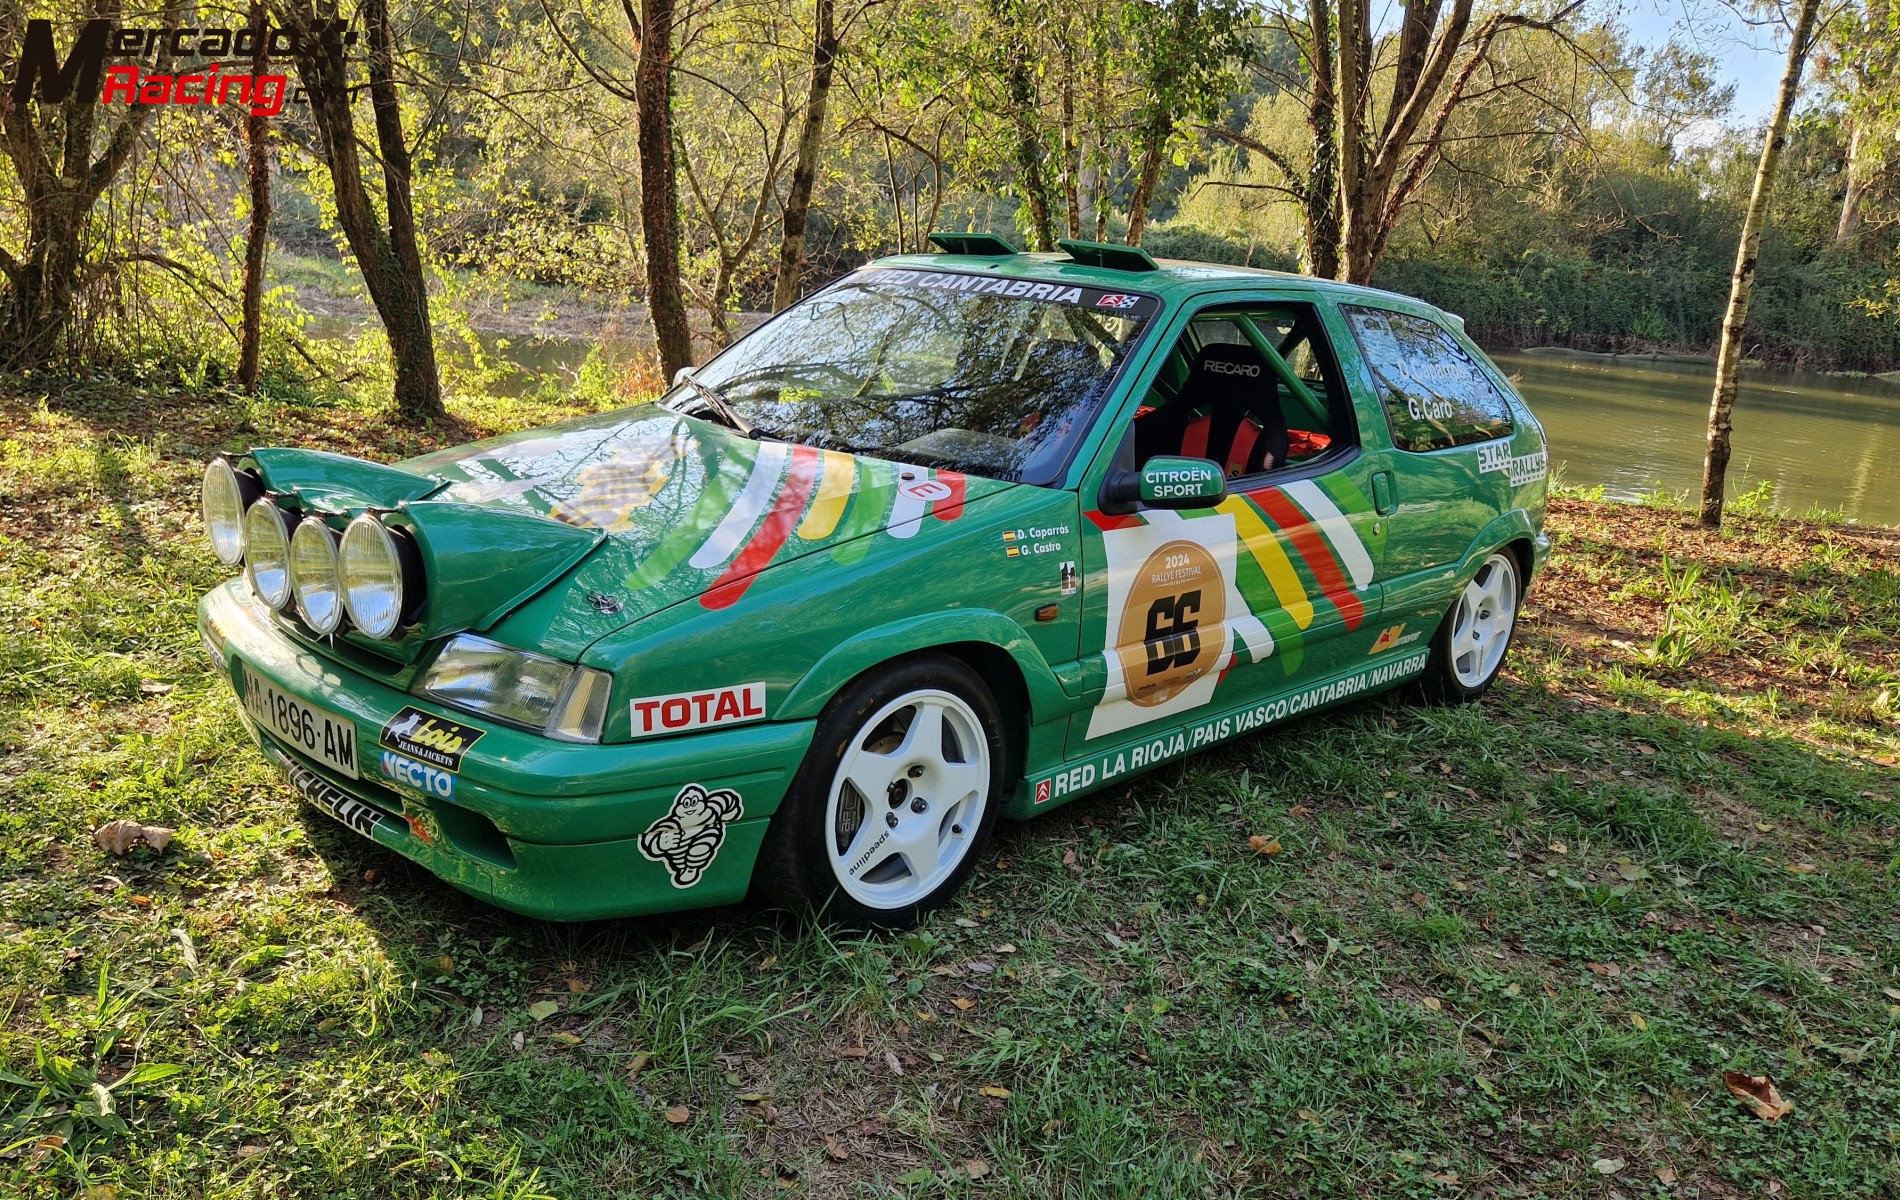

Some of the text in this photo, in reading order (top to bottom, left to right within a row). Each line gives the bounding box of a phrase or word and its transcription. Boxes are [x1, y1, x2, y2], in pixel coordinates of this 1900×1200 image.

[868, 269, 1083, 305] RED CANTABRIA
[1203, 359, 1261, 378] RECARO
[1477, 441, 1511, 465] STAR
[1145, 466, 1212, 484] CITROËN
[1511, 453, 1546, 478] RALLYE
[907, 482, 944, 498] E
[1153, 483, 1203, 498] SPORT
[1017, 523, 1069, 540] D. Caparrós
[1021, 542, 1062, 556] G. Castro
[1165, 553, 1190, 570] 2024
[1151, 565, 1202, 584] RALLYE FESTIVAL
[1144, 589, 1202, 677] 66
[634, 687, 763, 732] TOTAL
[410, 718, 463, 754] Lois
[382, 750, 452, 797] NECTO
[1054, 763, 1096, 798] RED
[1102, 752, 1126, 780] LA
[848, 830, 890, 876] speedline
